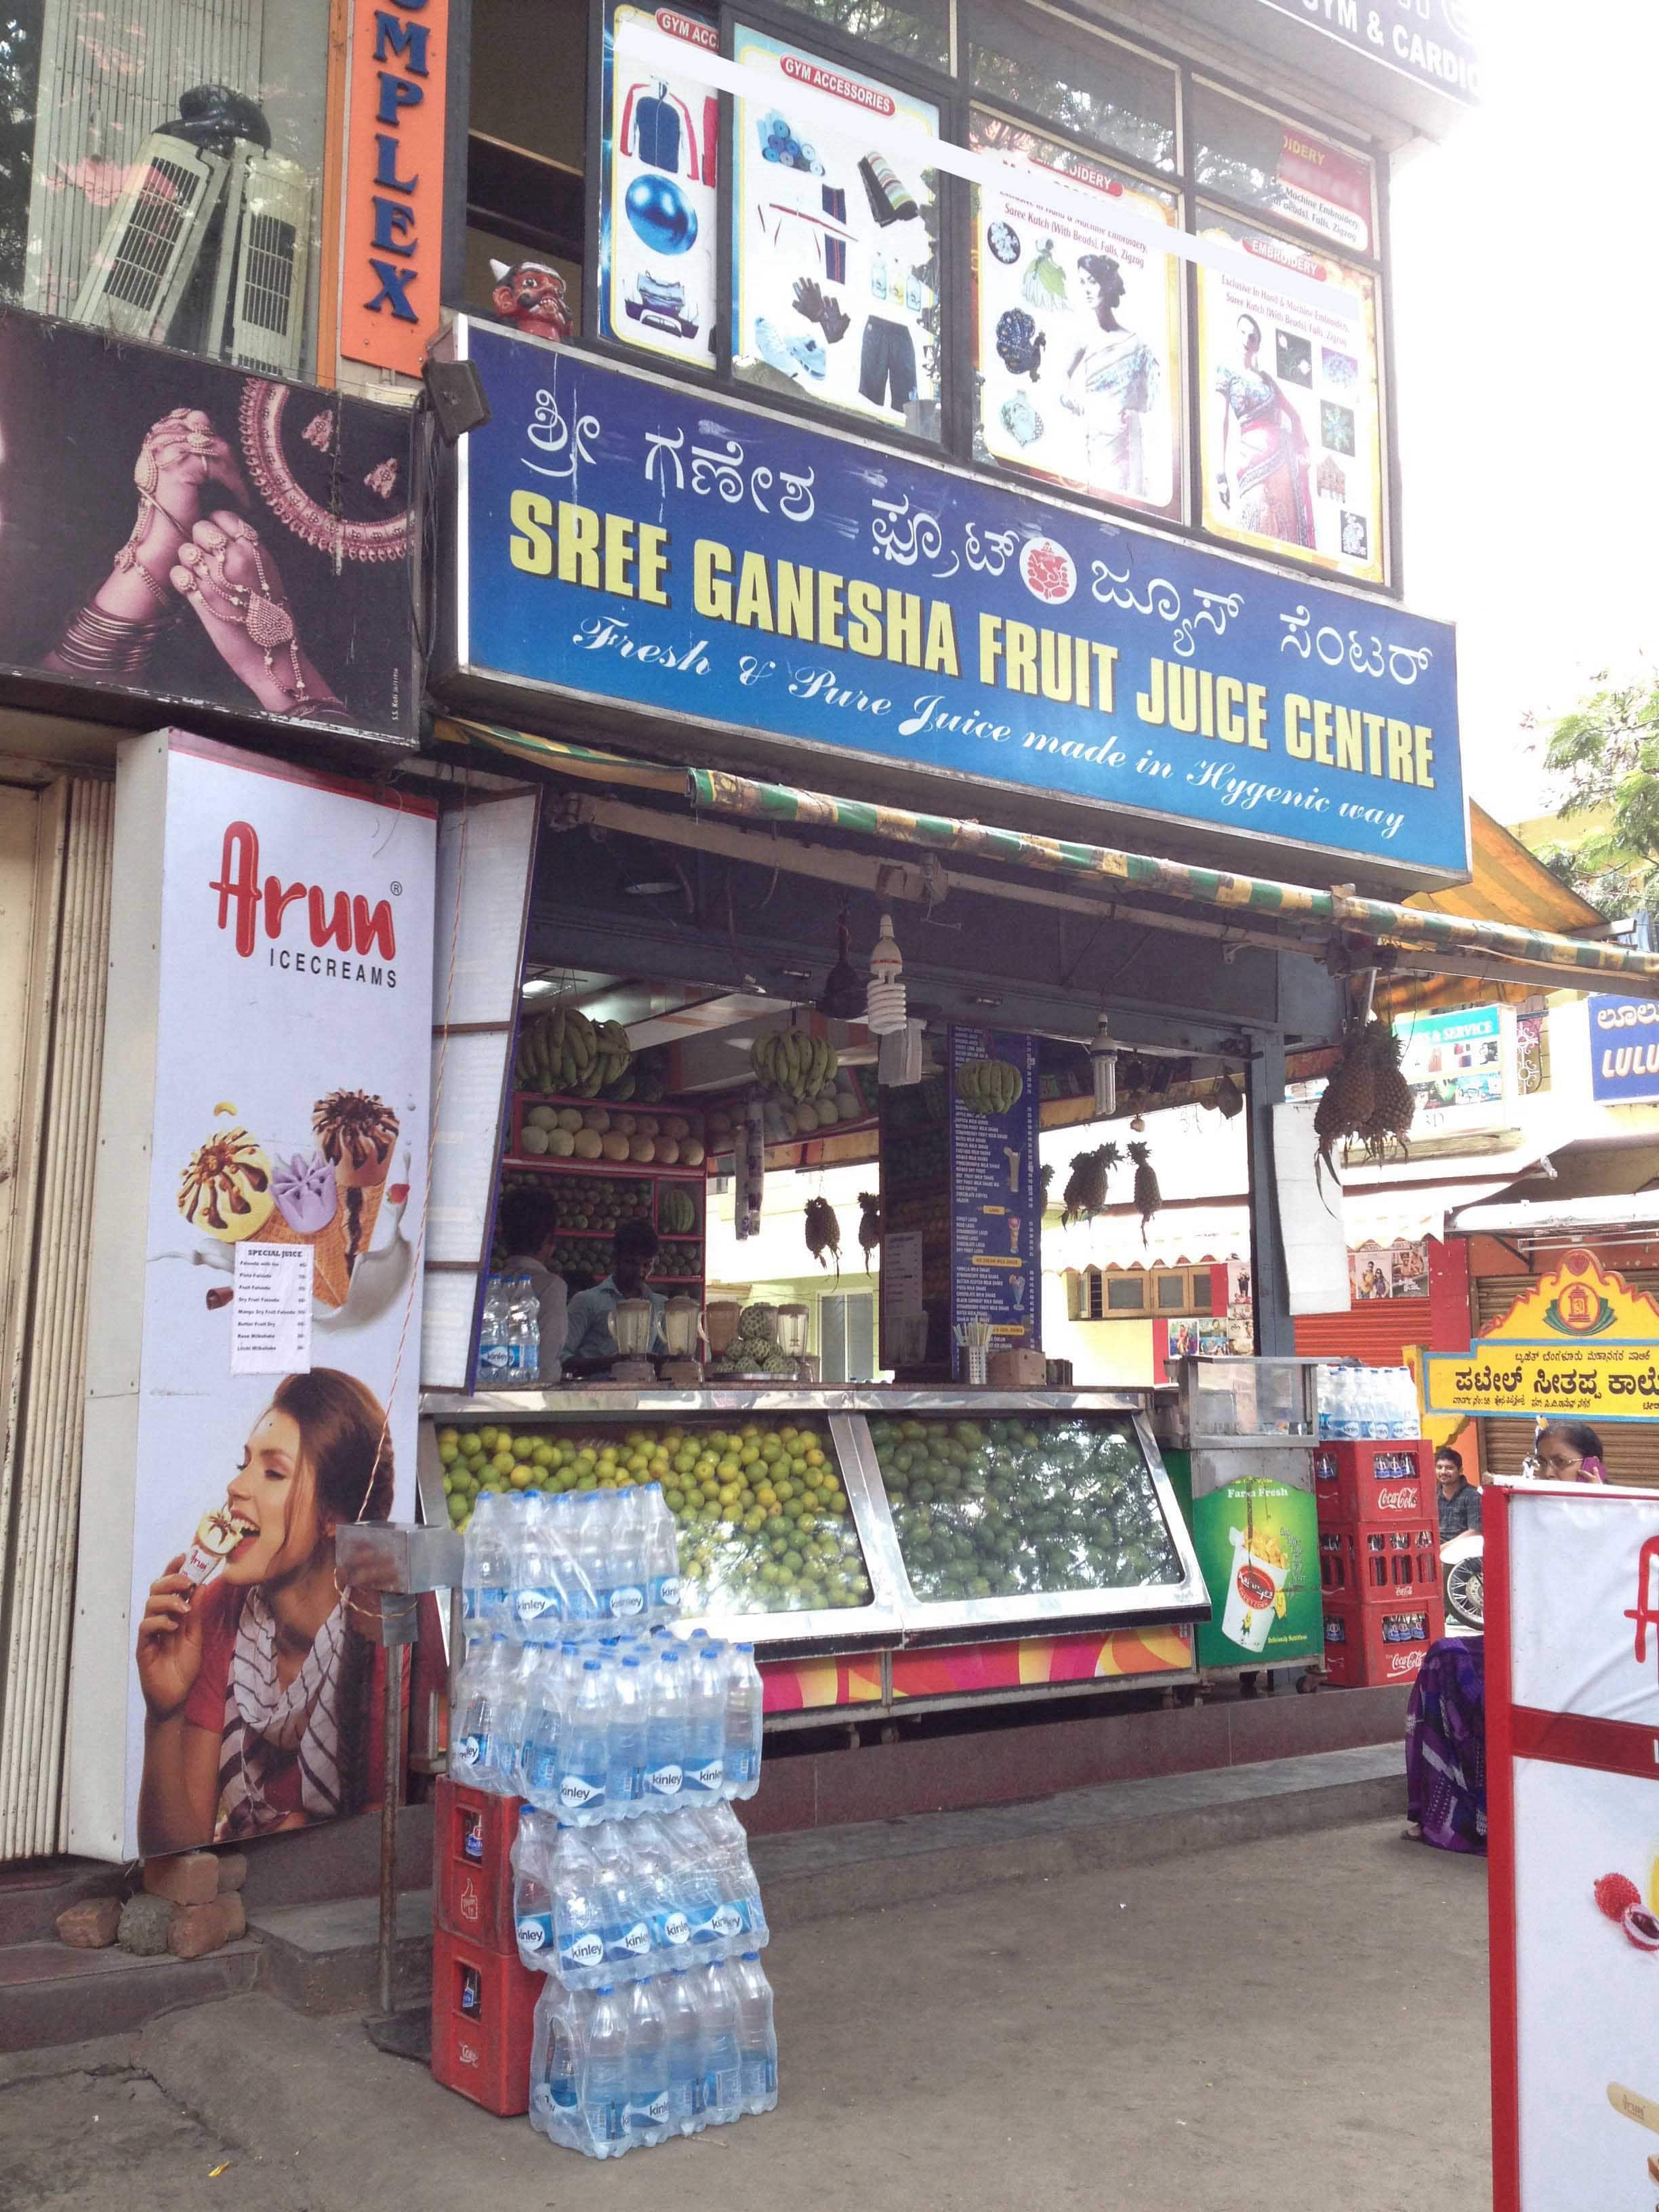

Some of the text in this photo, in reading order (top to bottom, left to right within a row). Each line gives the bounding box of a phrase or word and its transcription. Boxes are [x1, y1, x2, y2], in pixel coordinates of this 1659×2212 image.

[662, 14, 690, 37] GYM
[1367, 11, 1384, 47] &
[785, 58, 890, 113] GYM ACCESSORIES
[363, 0, 431, 324] MPLEX
[1004, 203, 1025, 220] Saree
[1028, 211, 1050, 232] Kutch
[1052, 222, 1071, 239] (With
[1121, 249, 1145, 269] Zigzag
[1221, 274, 1252, 295] Exclusive
[1261, 291, 1279, 306] Hand
[1226, 293, 1244, 306] Saree
[521, 388, 1433, 686] ಶ್ರೀ ಗಣೇಶ ಫ್ರೂಟ್ ಜ್ಯೂಸ್ ಸೆಂಟರ್
[510, 490, 1437, 790] SREE GANESHA FRUIT JUICE CENTRE
[573, 615, 1405, 840] Fresh & Pure Juice made in Hygenic way
[209, 821, 396, 961] Arun
[270, 948, 398, 988] ICECREAMS
[1443, 1021, 1493, 1040] SERVICE
[248, 1249, 303, 1258] SPECIAL JUICE
[1455, 1366, 1523, 1392] ಪಟೇಲ್
[1533, 1368, 1602, 1399] ಸೀತಪ್ಪ
[1258, 1488, 1288, 1498] Fresh
[517, 1601, 546, 1612] kinley
[652, 1773, 682, 1786] kinley
[571, 1943, 602, 1959] kinley
